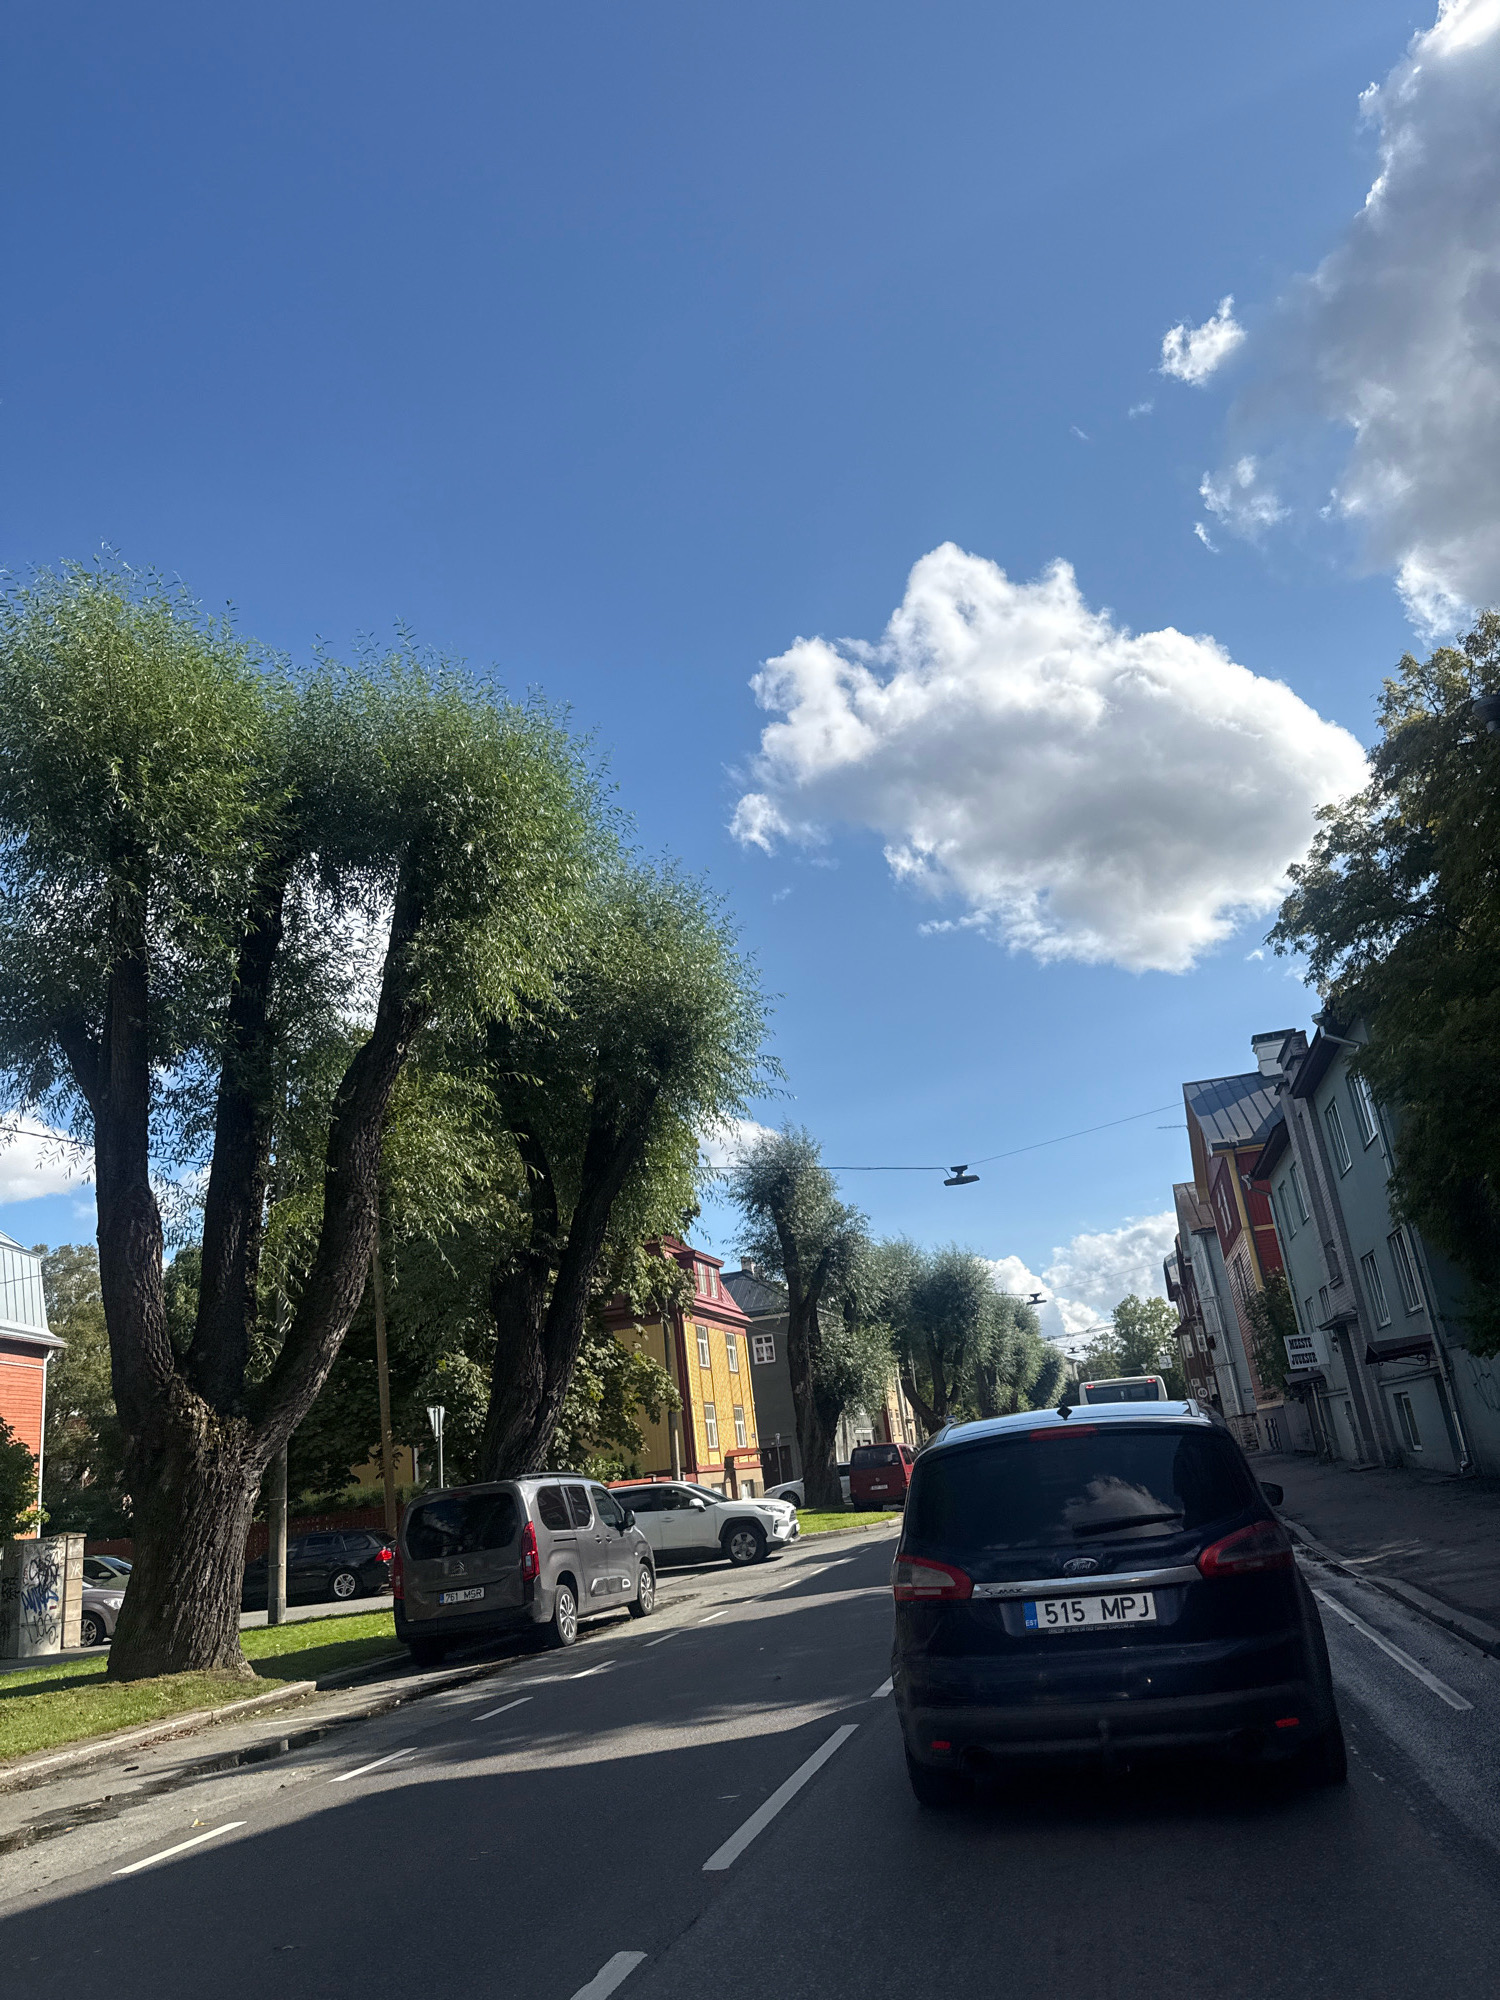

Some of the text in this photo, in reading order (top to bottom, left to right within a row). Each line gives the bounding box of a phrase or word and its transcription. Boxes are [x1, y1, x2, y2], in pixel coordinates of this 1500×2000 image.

[445, 1588, 482, 1603] 761 MSR
[1043, 1595, 1149, 1624] 515 MPJ
